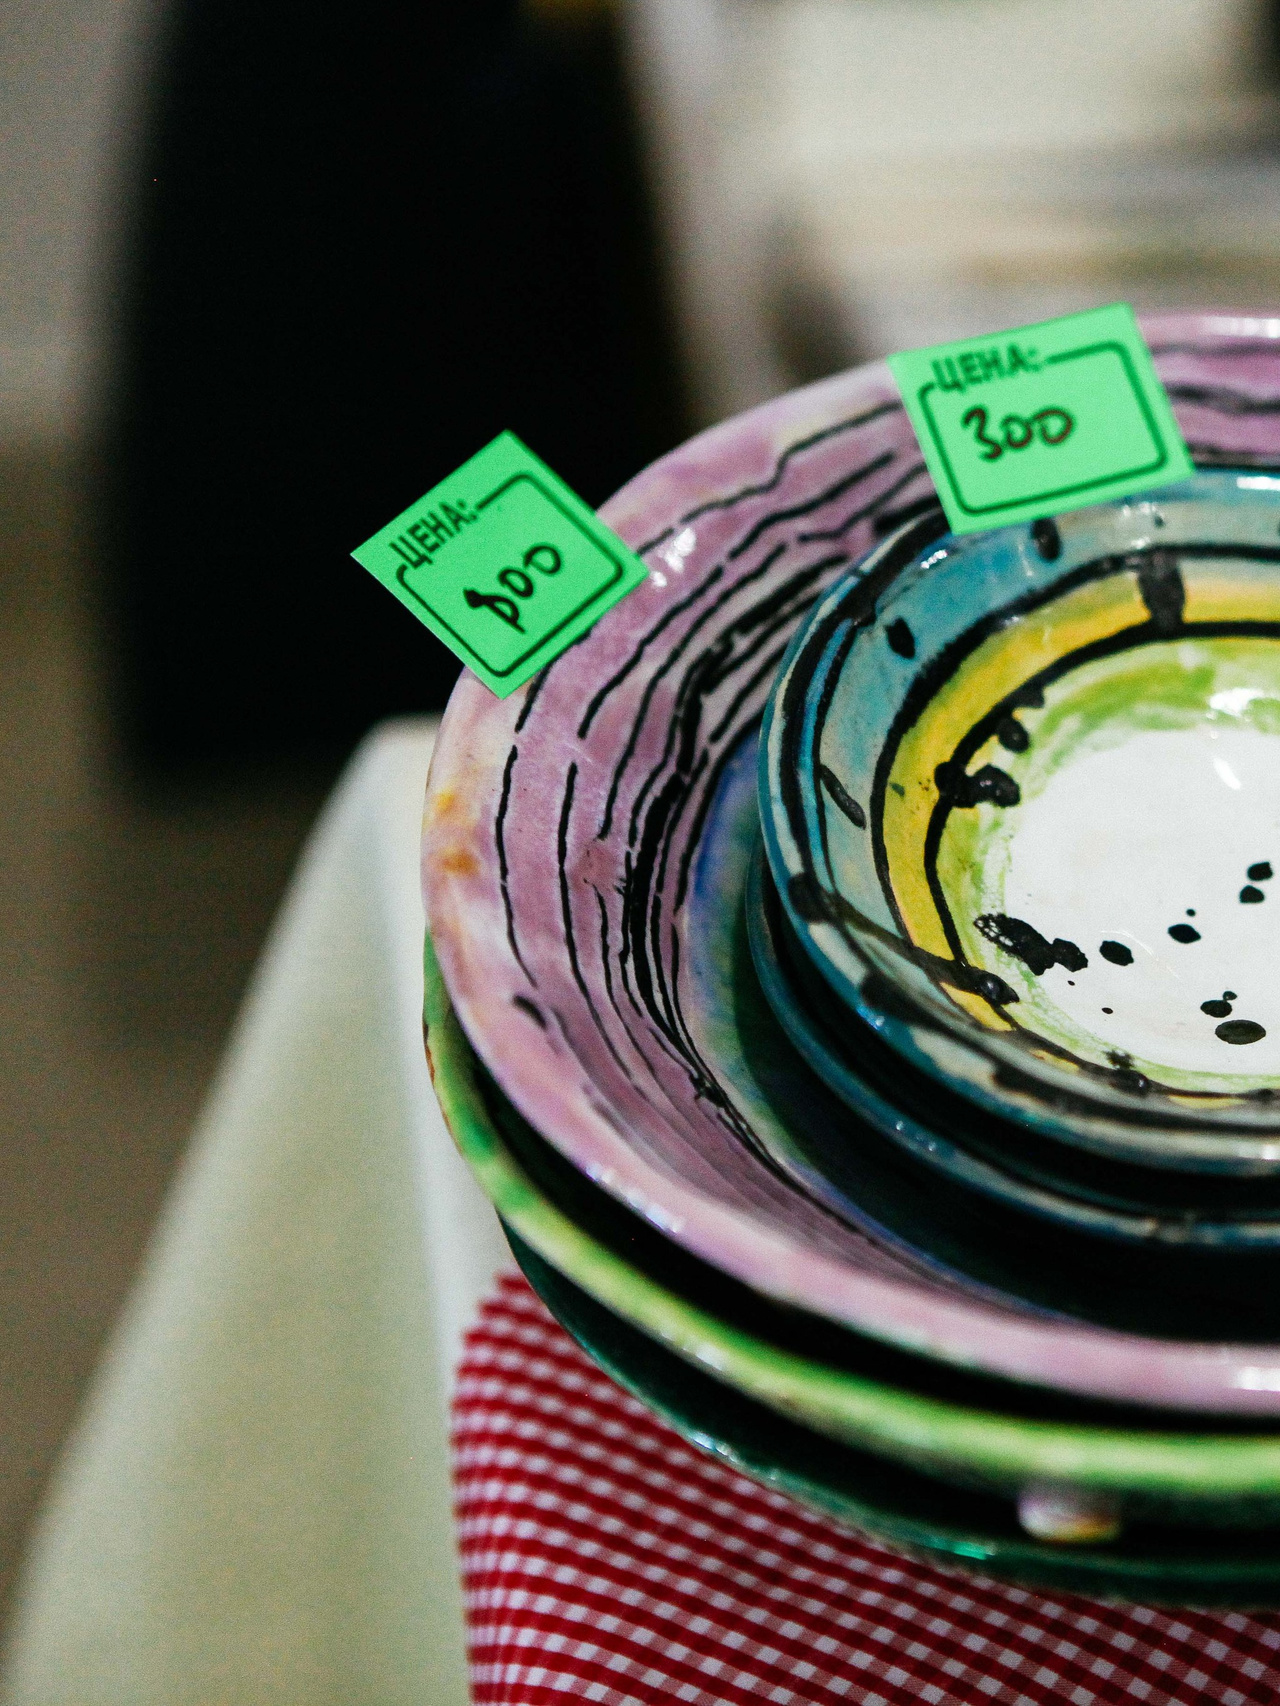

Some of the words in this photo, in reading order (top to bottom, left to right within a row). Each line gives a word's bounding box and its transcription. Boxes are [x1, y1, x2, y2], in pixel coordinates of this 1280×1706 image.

[931, 344, 1041, 393] ЦЕНА:
[962, 406, 1073, 461] 300
[388, 499, 477, 568] ЦЕНА:
